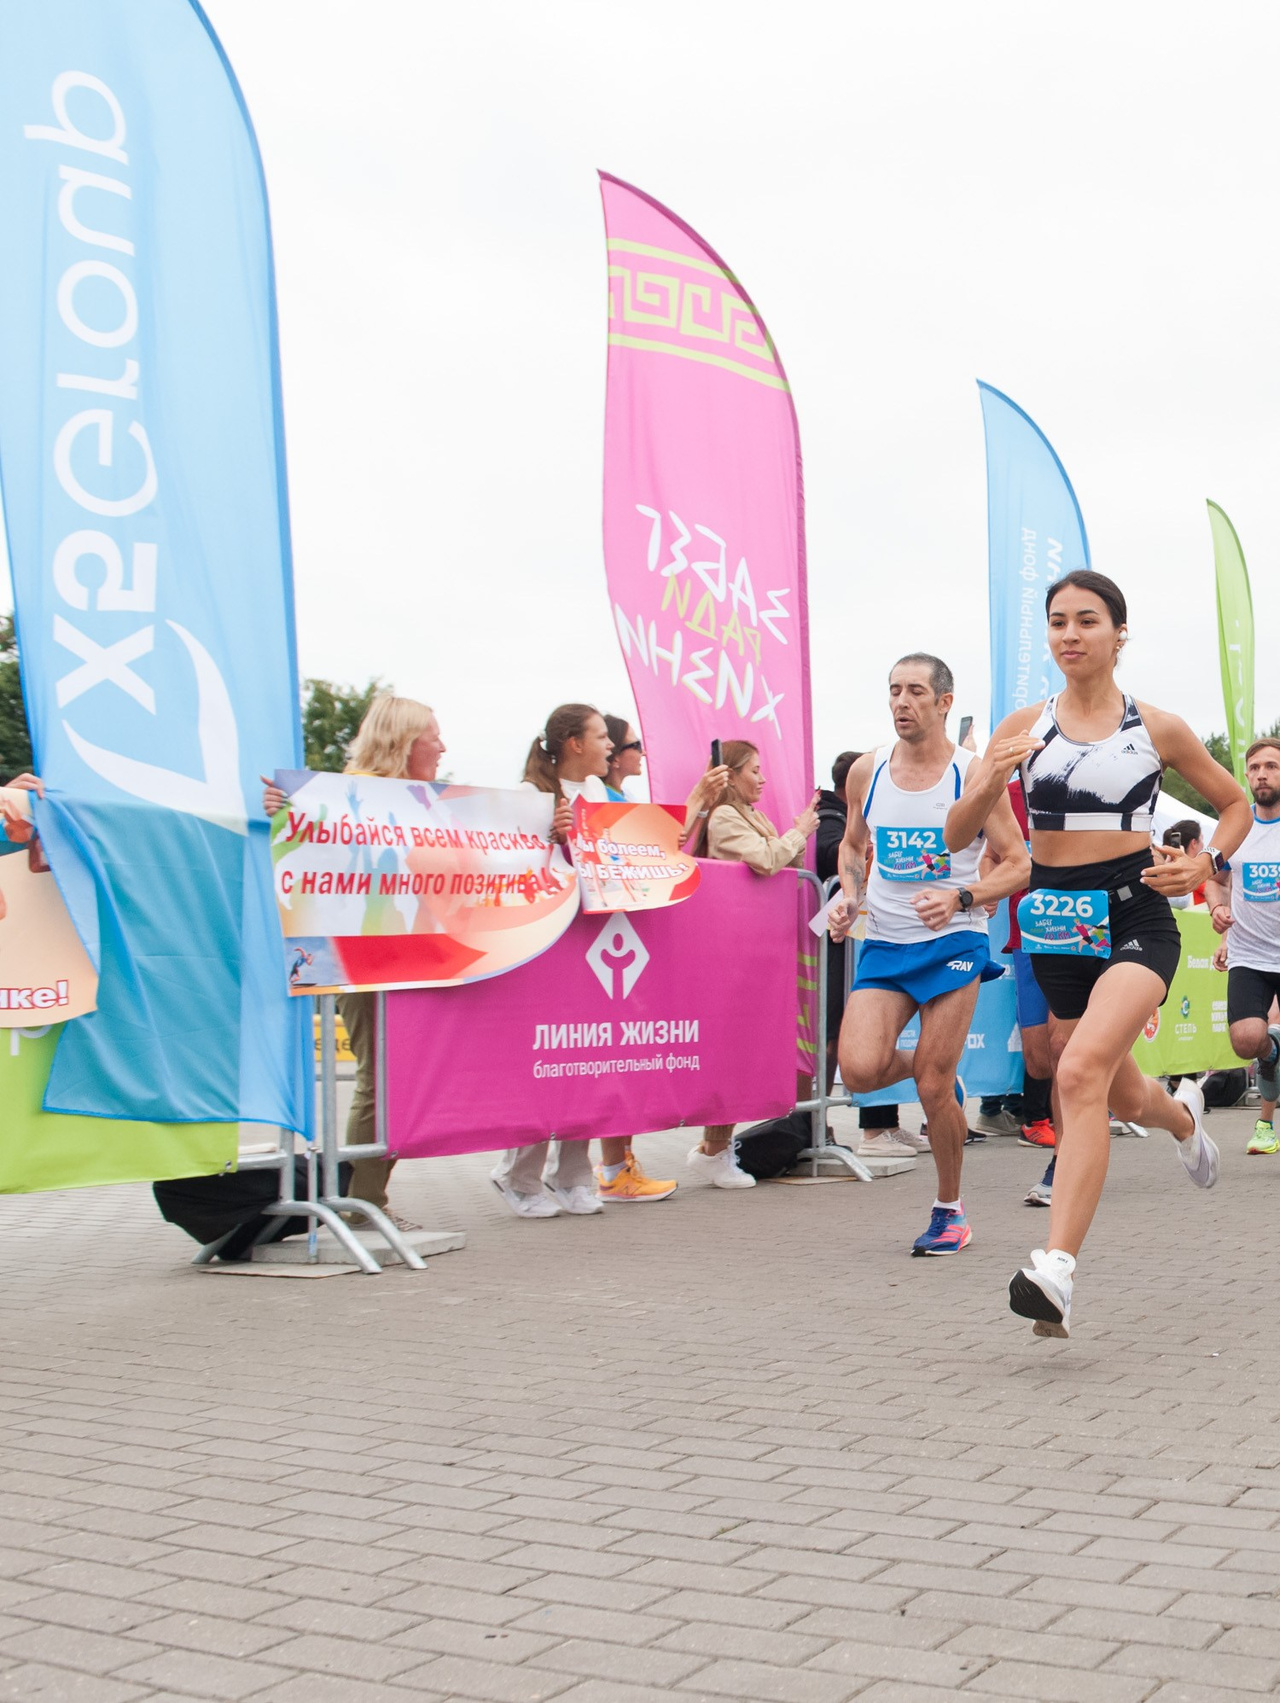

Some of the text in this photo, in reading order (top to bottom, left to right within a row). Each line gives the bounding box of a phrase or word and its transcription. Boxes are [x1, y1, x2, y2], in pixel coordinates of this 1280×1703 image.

[285, 811, 407, 846] Улыбайся
[410, 826, 464, 849] всем
[886, 831, 937, 848] 3142
[597, 838, 666, 860] болеем,
[281, 871, 293, 894] с
[301, 871, 371, 895] нами
[379, 872, 445, 895] много
[1030, 893, 1093, 918] 3226
[946, 960, 974, 972] RAY
[532, 1019, 700, 1051] ЛИНИЯ ЖИЗНИ
[533, 1051, 699, 1080] благотворительный фонд
